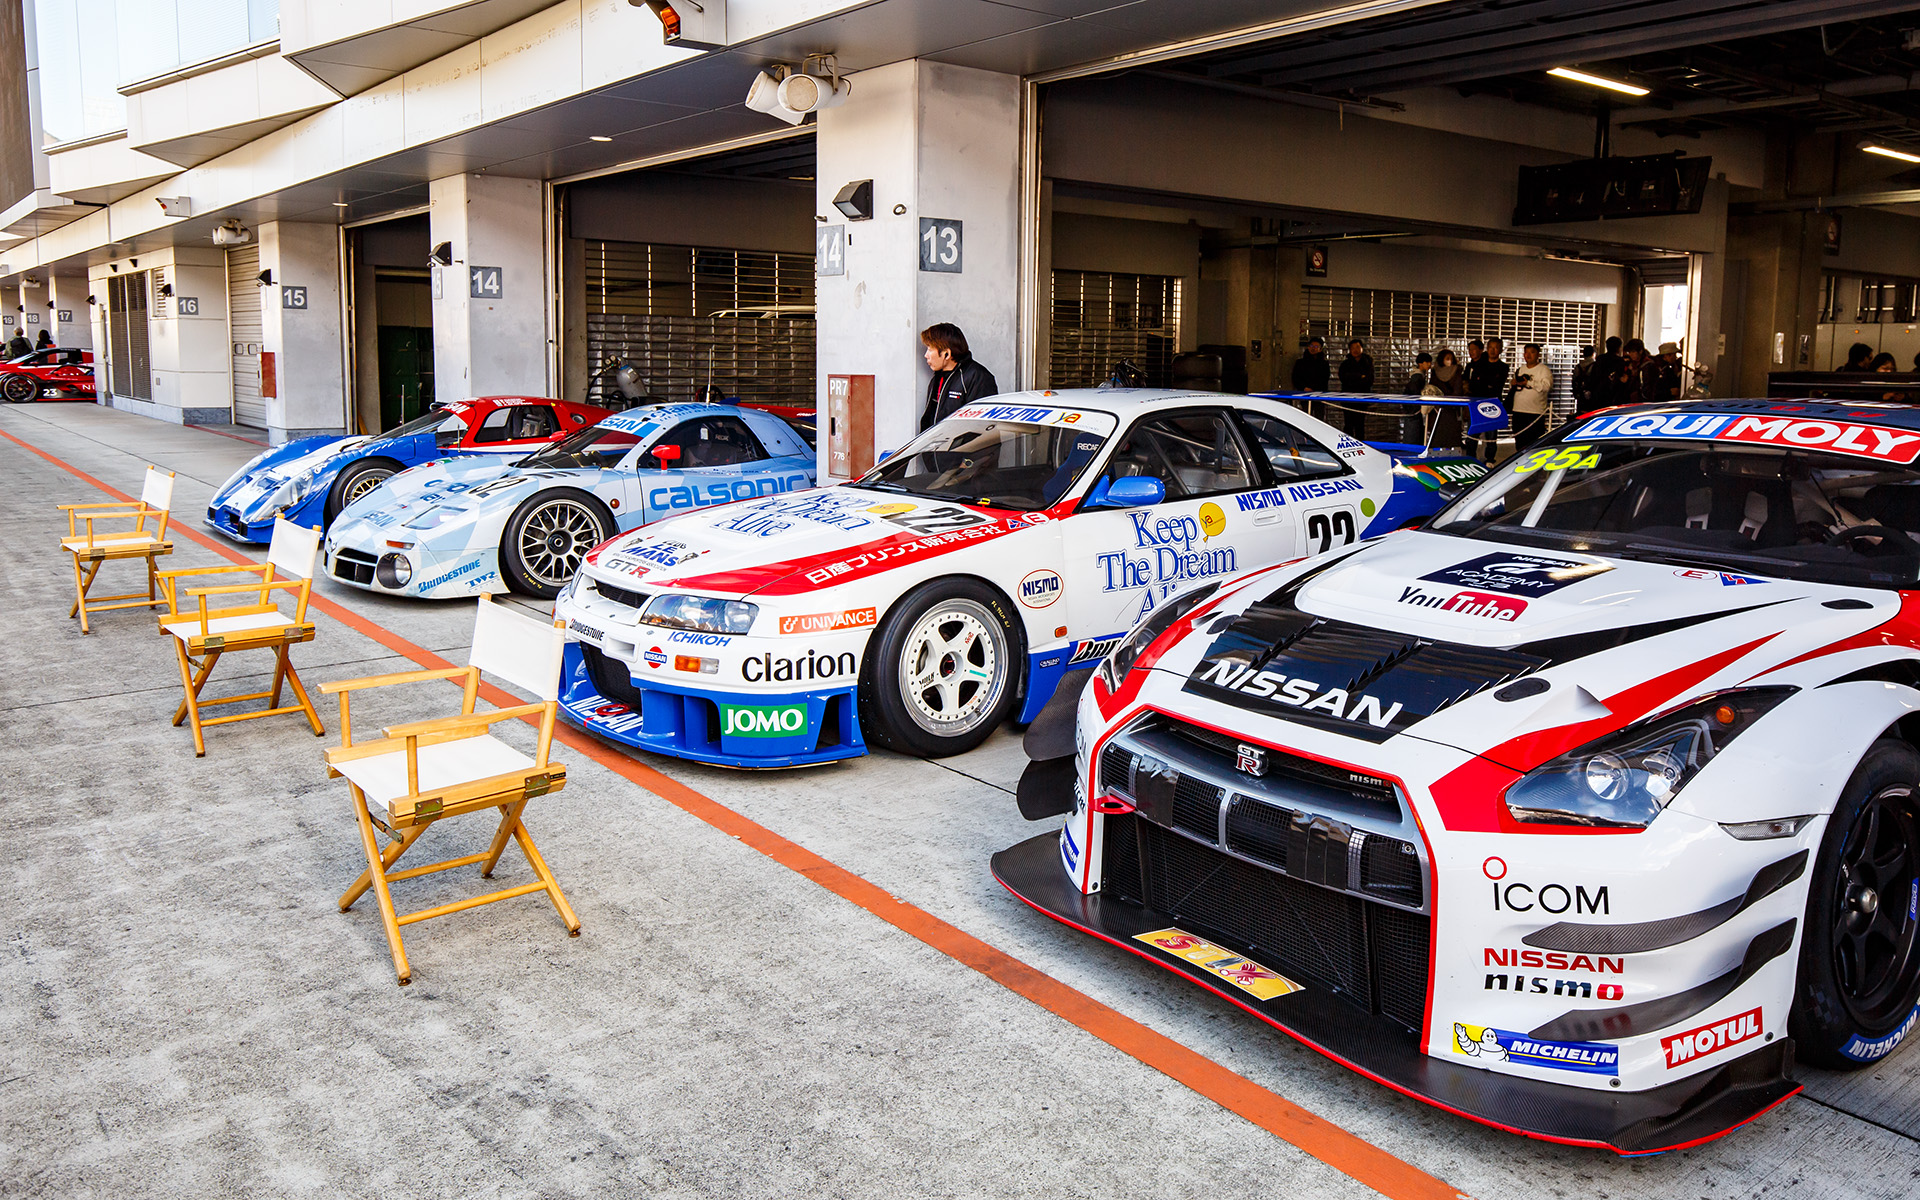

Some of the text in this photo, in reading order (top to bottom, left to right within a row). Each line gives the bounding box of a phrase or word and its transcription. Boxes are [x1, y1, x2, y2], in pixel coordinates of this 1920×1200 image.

[819, 232, 842, 269] 14
[923, 225, 959, 265] 13
[472, 270, 500, 294] 14
[179, 299, 197, 313] 16
[283, 289, 305, 306] 15
[3, 316, 13, 324] 19
[27, 314, 38, 323] 18
[58, 311, 71, 320] 17
[43, 388, 57, 397] 23
[830, 380, 848, 395] PR7
[980, 406, 1053, 422] NISMO
[1574, 415, 1920, 456] LIQUI MOLY
[1437, 461, 1489, 482] JOMO
[1235, 479, 1364, 512] NISMO NISSAN
[888, 507, 986, 534] 22
[1126, 509, 1198, 550] Keep
[621, 546, 680, 567] MANS
[650, 543, 677, 554] LE
[805, 524, 1006, 585] 日産プリンス販売会社
[1096, 545, 1238, 593] The Dream
[1511, 555, 1582, 569] NISSAN
[418, 558, 481, 593] BRIDGESTONE
[465, 571, 497, 588] TWR
[1022, 576, 1059, 597] NISMO
[1446, 569, 1555, 588] ACADEMY
[569, 618, 605, 642] BRIDGESTONE
[801, 610, 875, 630] UNIVANCE
[667, 631, 732, 647] ICHIKOH
[644, 651, 667, 664] NISSAN
[1199, 659, 1404, 729] NISSAN
[725, 708, 804, 735] JOMO
[1483, 947, 1625, 974] NISSAN
[1484, 974, 1625, 1001] nismo
[1671, 1014, 1760, 1065] MOTUL
[1848, 1010, 1918, 1059] MICHELIN
[1509, 1040, 1618, 1064] MICHELIN
